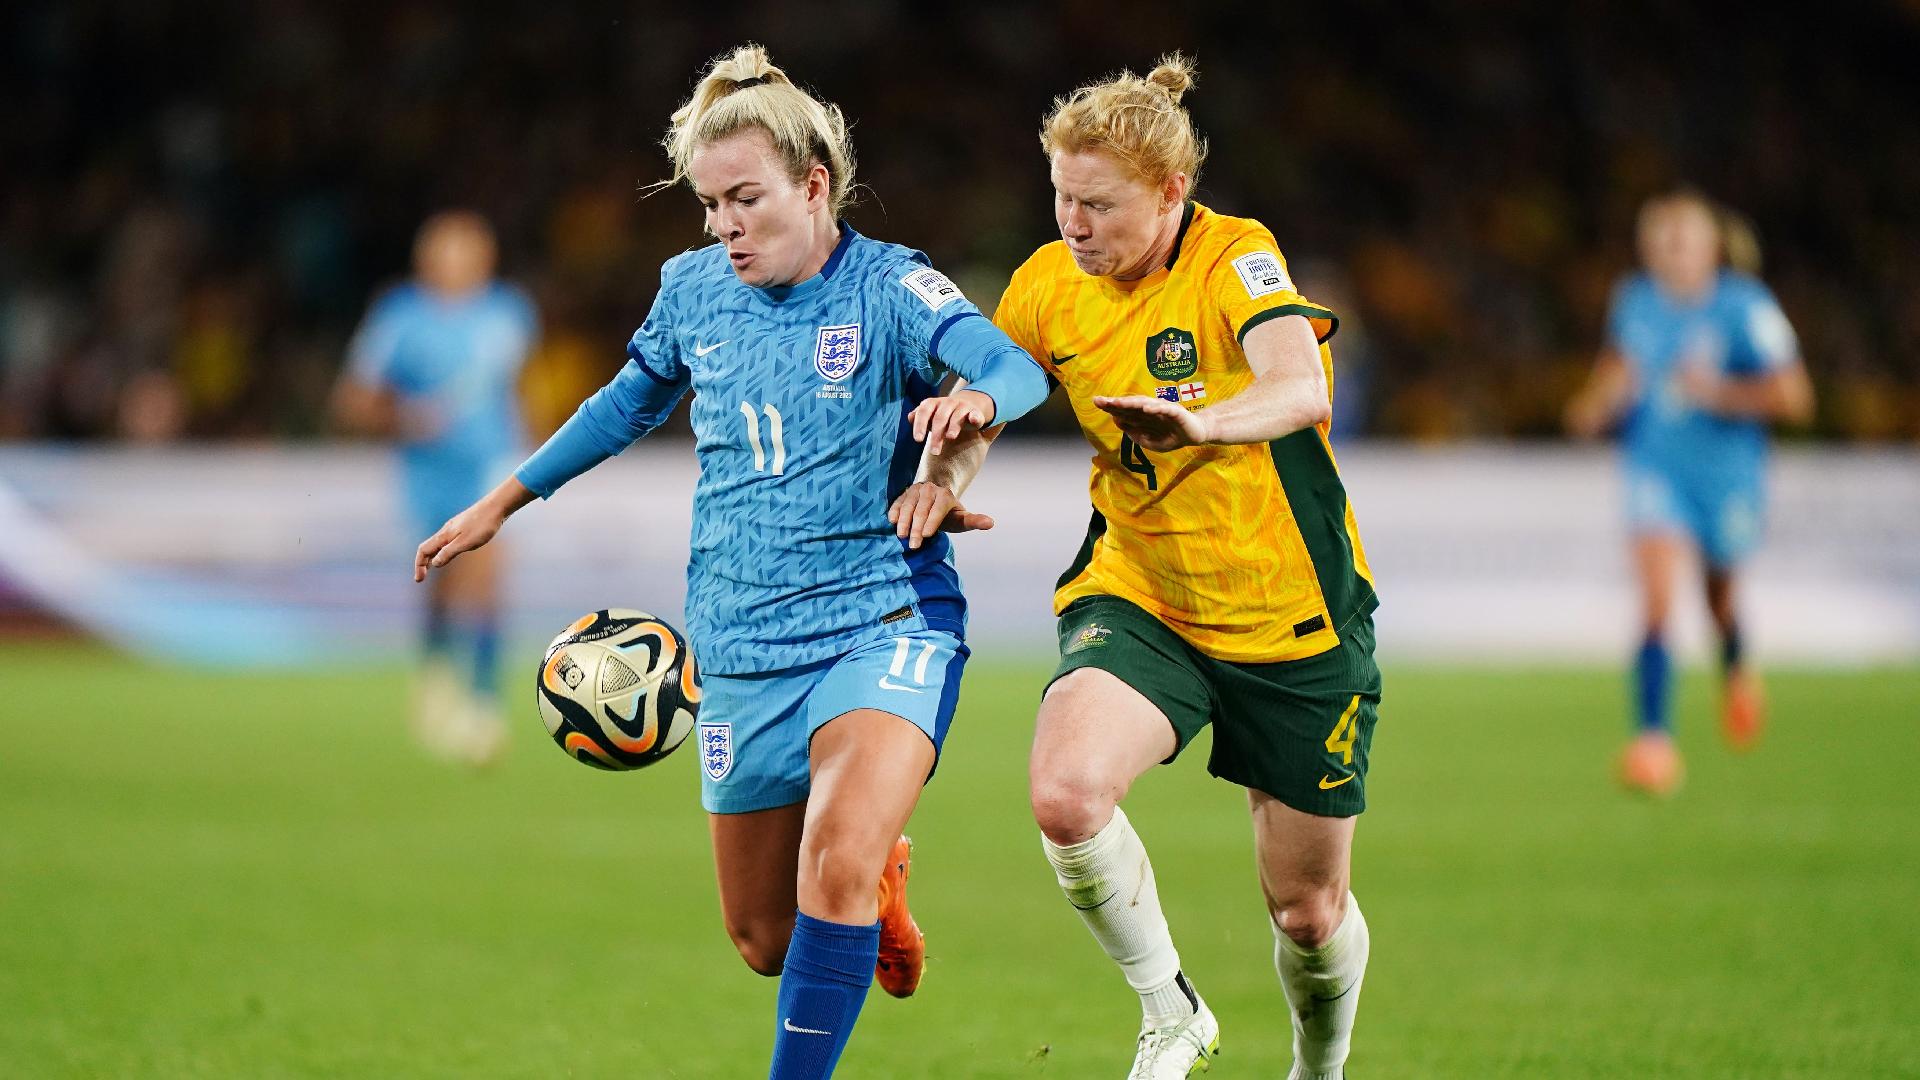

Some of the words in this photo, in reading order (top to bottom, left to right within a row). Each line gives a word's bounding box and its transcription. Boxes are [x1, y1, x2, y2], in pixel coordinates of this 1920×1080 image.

[1248, 263, 1278, 274] UNITES
[1157, 359, 1191, 369] AUSTRALIA
[740, 400, 786, 476] 11
[1120, 428, 1158, 491] 4
[889, 637, 937, 686] 11
[1325, 694, 1361, 765] 4
